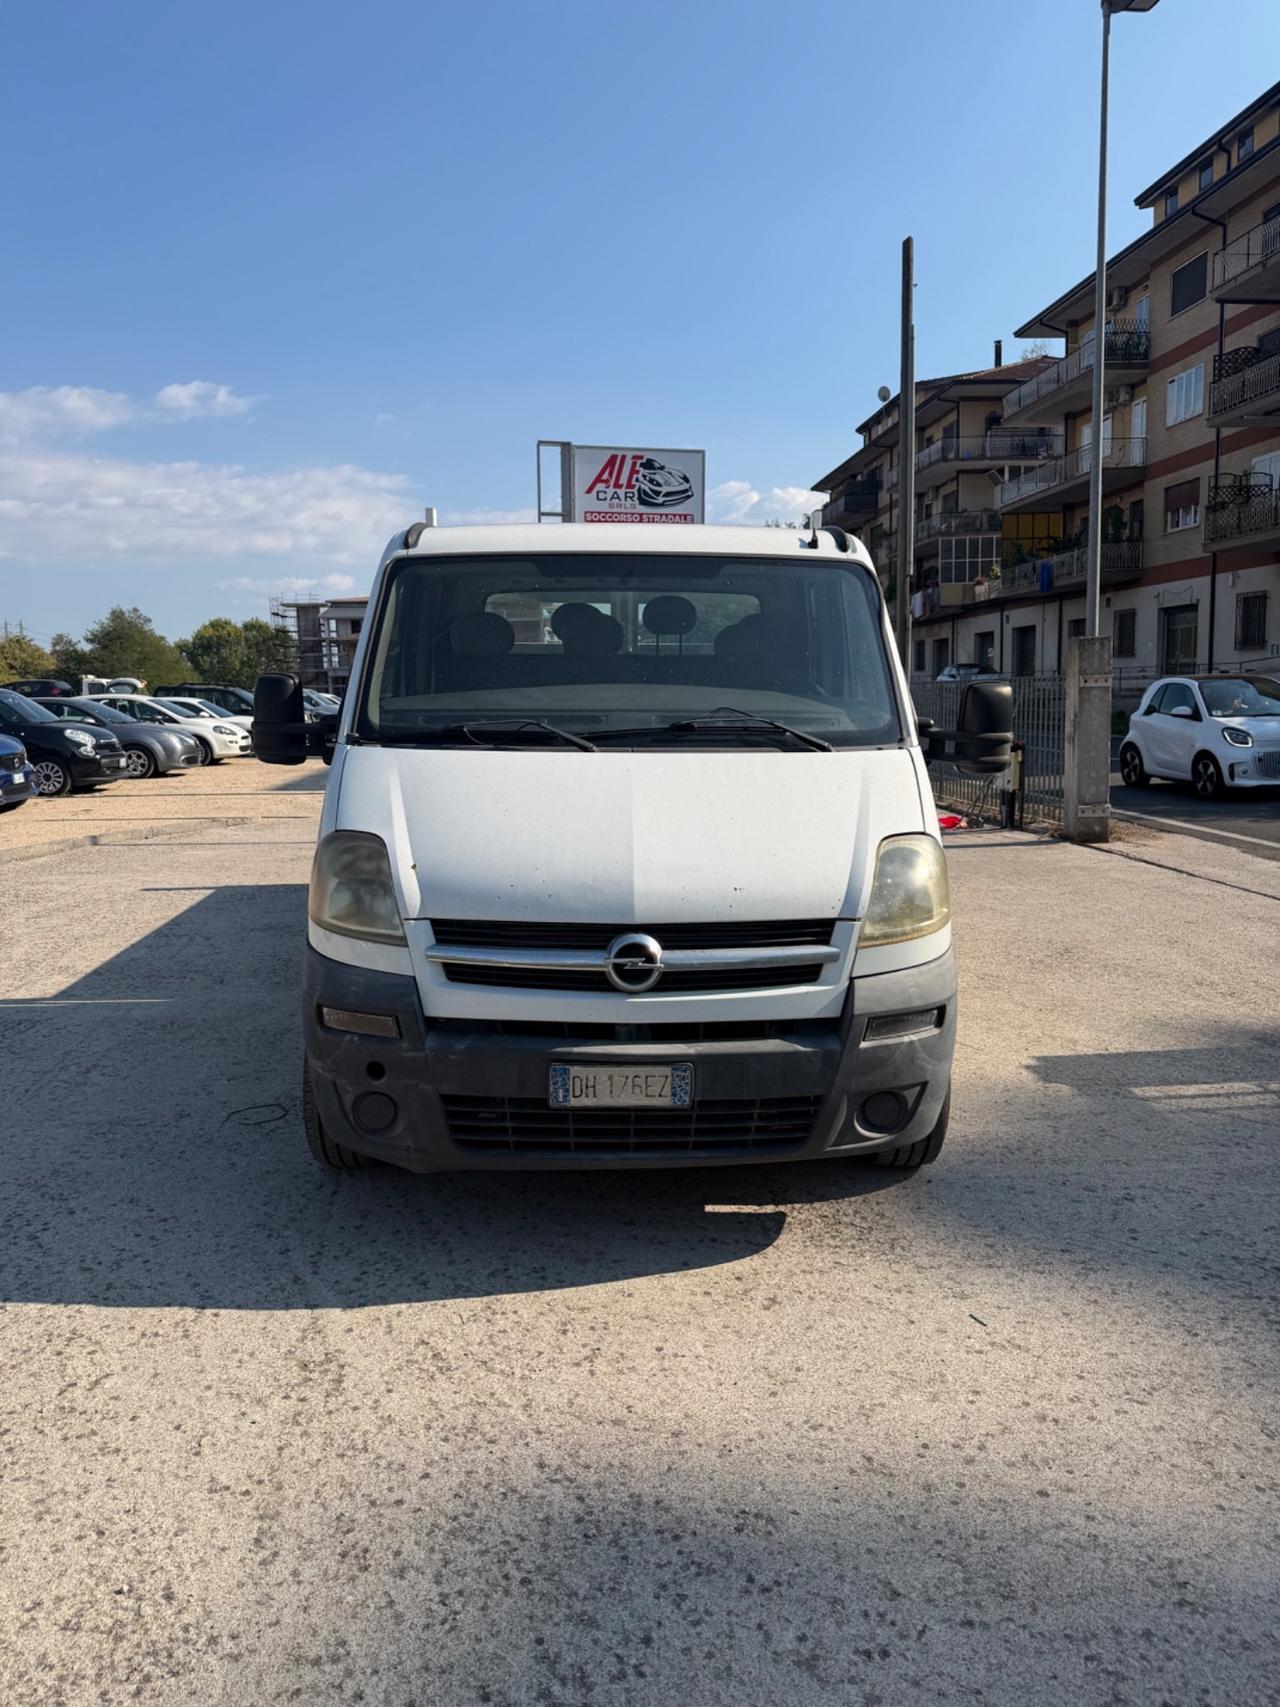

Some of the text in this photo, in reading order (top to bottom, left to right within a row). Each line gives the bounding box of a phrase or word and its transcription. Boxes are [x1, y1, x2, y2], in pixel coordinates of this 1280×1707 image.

[584, 454, 645, 494] ALE
[596, 490, 636, 502] CAR
[585, 512, 692, 523] SOCCORSO STRADALE
[572, 1075, 597, 1098] DH
